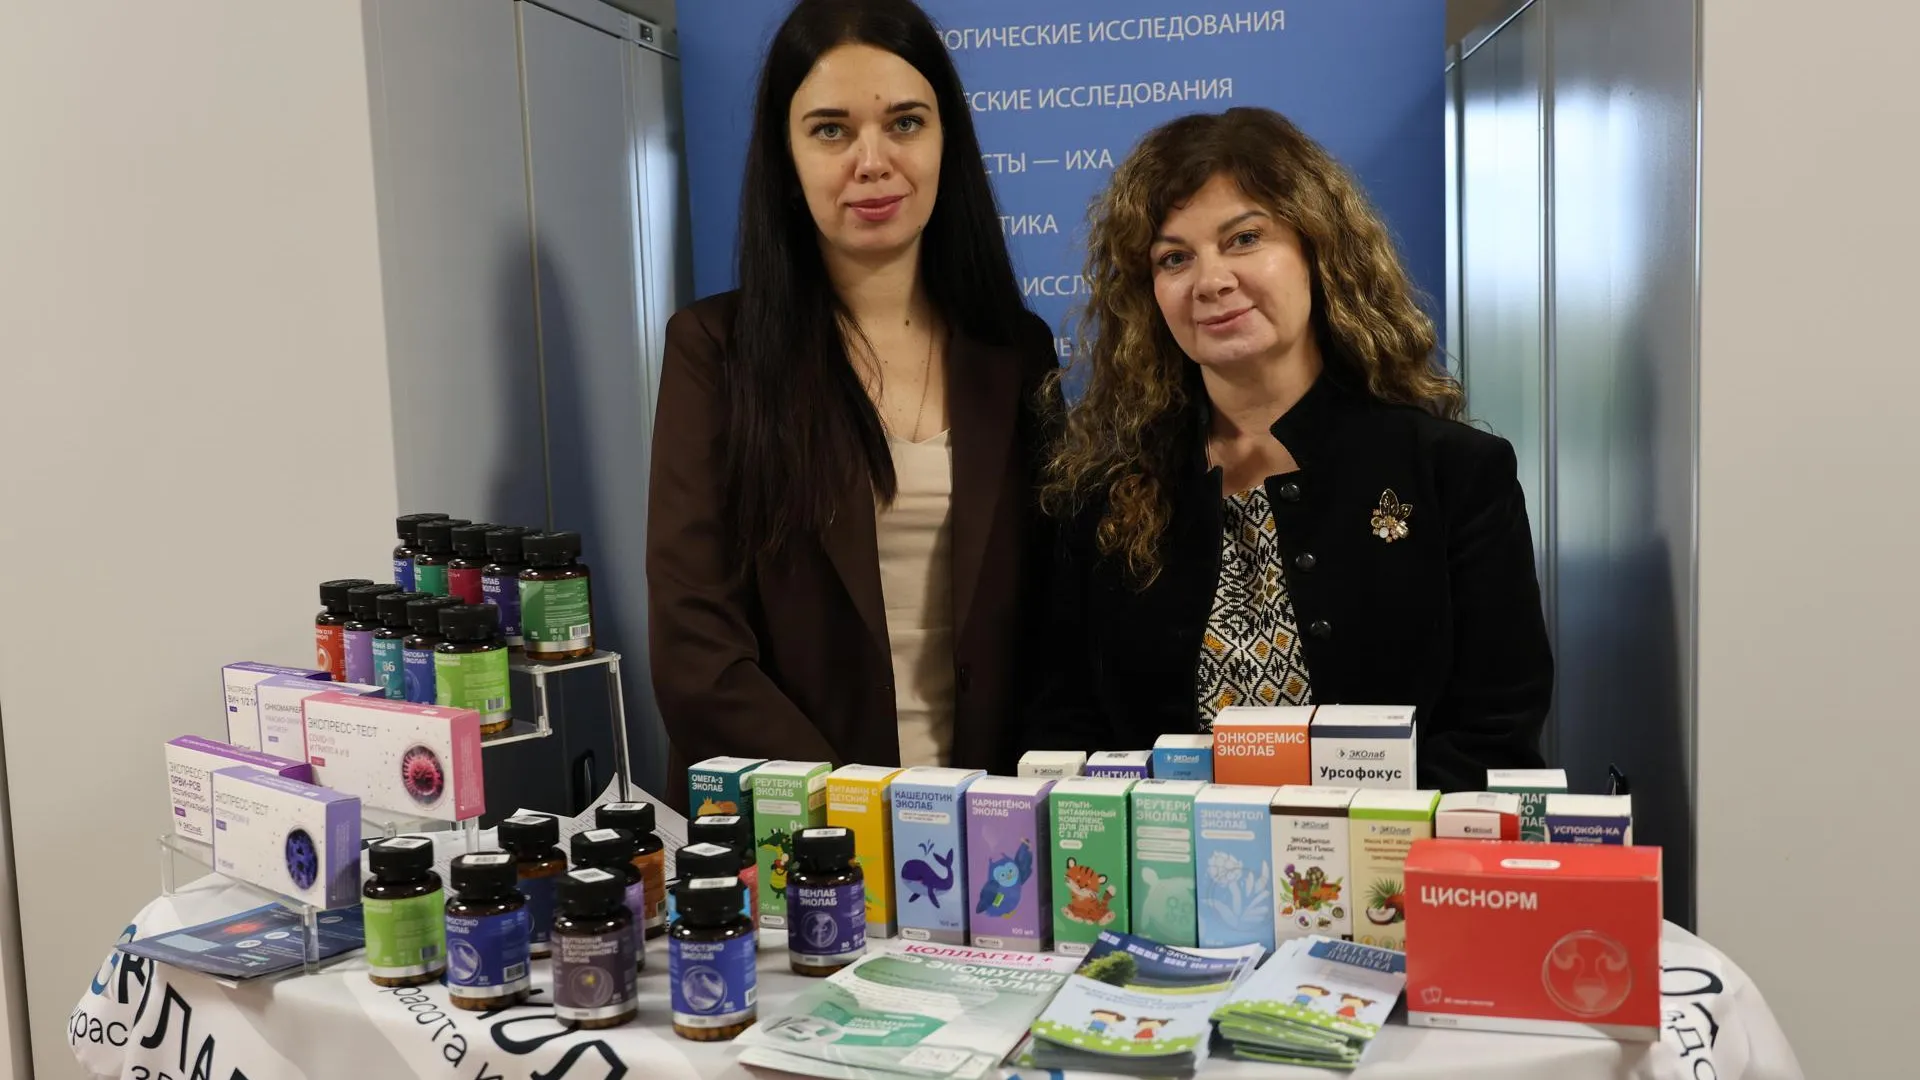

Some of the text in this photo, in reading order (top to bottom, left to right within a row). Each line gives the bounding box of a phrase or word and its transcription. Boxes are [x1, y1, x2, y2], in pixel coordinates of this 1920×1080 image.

[939, 9, 1285, 50] ОГИЧЕСКИЕ ИССЛЕДОВАНИЯ
[1038, 77, 1233, 109] ИССЛЕДОВАНИЯ
[1065, 148, 1115, 171] ИХА
[998, 213, 1060, 236] ТИКА
[307, 717, 378, 738] ЭКСПРЕСС-ТЕСТ
[1216, 731, 1306, 744] ОНКОРЕМИС
[1217, 744, 1276, 757] ЭКОЛАБ
[1347, 749, 1386, 760] ЭКОлаб
[691, 774, 724, 784] ОМЕГА-3
[1091, 770, 1141, 780] ИНТИМ
[1319, 766, 1402, 781] Урсофокус
[691, 782, 724, 792] ЭКОЛАБ
[755, 777, 803, 789] РЕУТЕРИН
[756, 787, 795, 797] ЭКОЛАБ
[895, 800, 934, 811] ЭКОЛАБ
[972, 807, 1009, 818] ЭКОЛАБ
[1136, 810, 1188, 823] ЭКОЛАБ
[1200, 808, 1264, 820] ЭКОФИТОЛ
[1200, 819, 1248, 830] ЭКОЛАБ
[1553, 824, 1620, 836] УСПОКОЙ-КА
[799, 888, 836, 898] ВЕНЛАБ
[1420, 885, 1538, 910] ЦИСНОРМ
[904, 944, 1035, 962] КОЛЛАГЕН
[925, 960, 1066, 984] ЭКОМУЦИЛ
[951, 974, 1056, 992] ЭКОЛАБ
